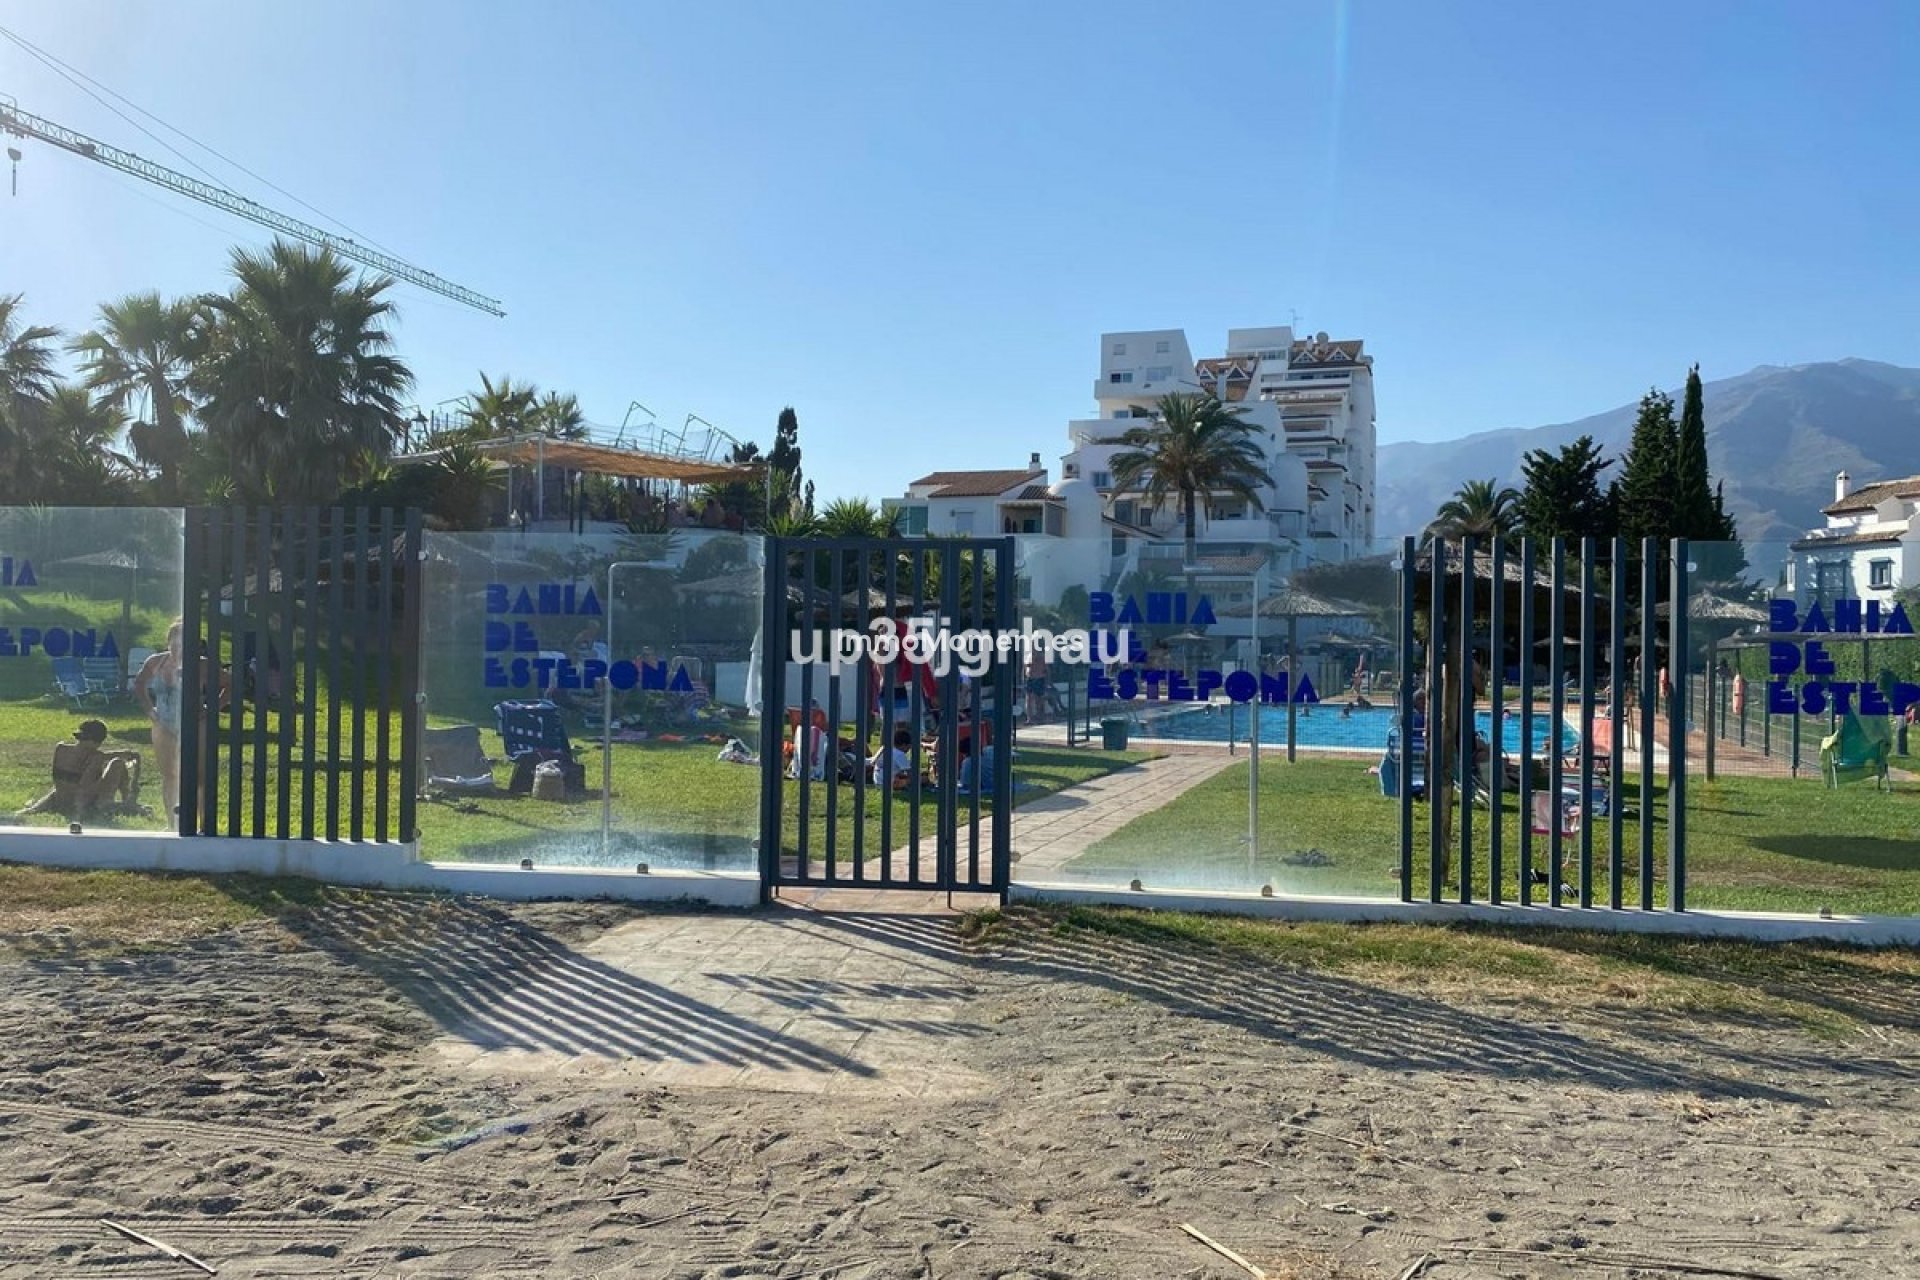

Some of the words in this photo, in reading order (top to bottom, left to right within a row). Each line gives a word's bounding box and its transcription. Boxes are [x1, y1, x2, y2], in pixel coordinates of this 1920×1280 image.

[486, 584, 603, 615] BAHIA
[1090, 592, 1217, 624] BAHIA
[1769, 599, 1914, 632] BAHIA
[485, 621, 538, 652] DE
[1090, 630, 1147, 663] DE
[485, 657, 694, 691] ESTEPONA
[1769, 641, 1835, 674] DE
[1087, 669, 1320, 703] ESTEPONA
